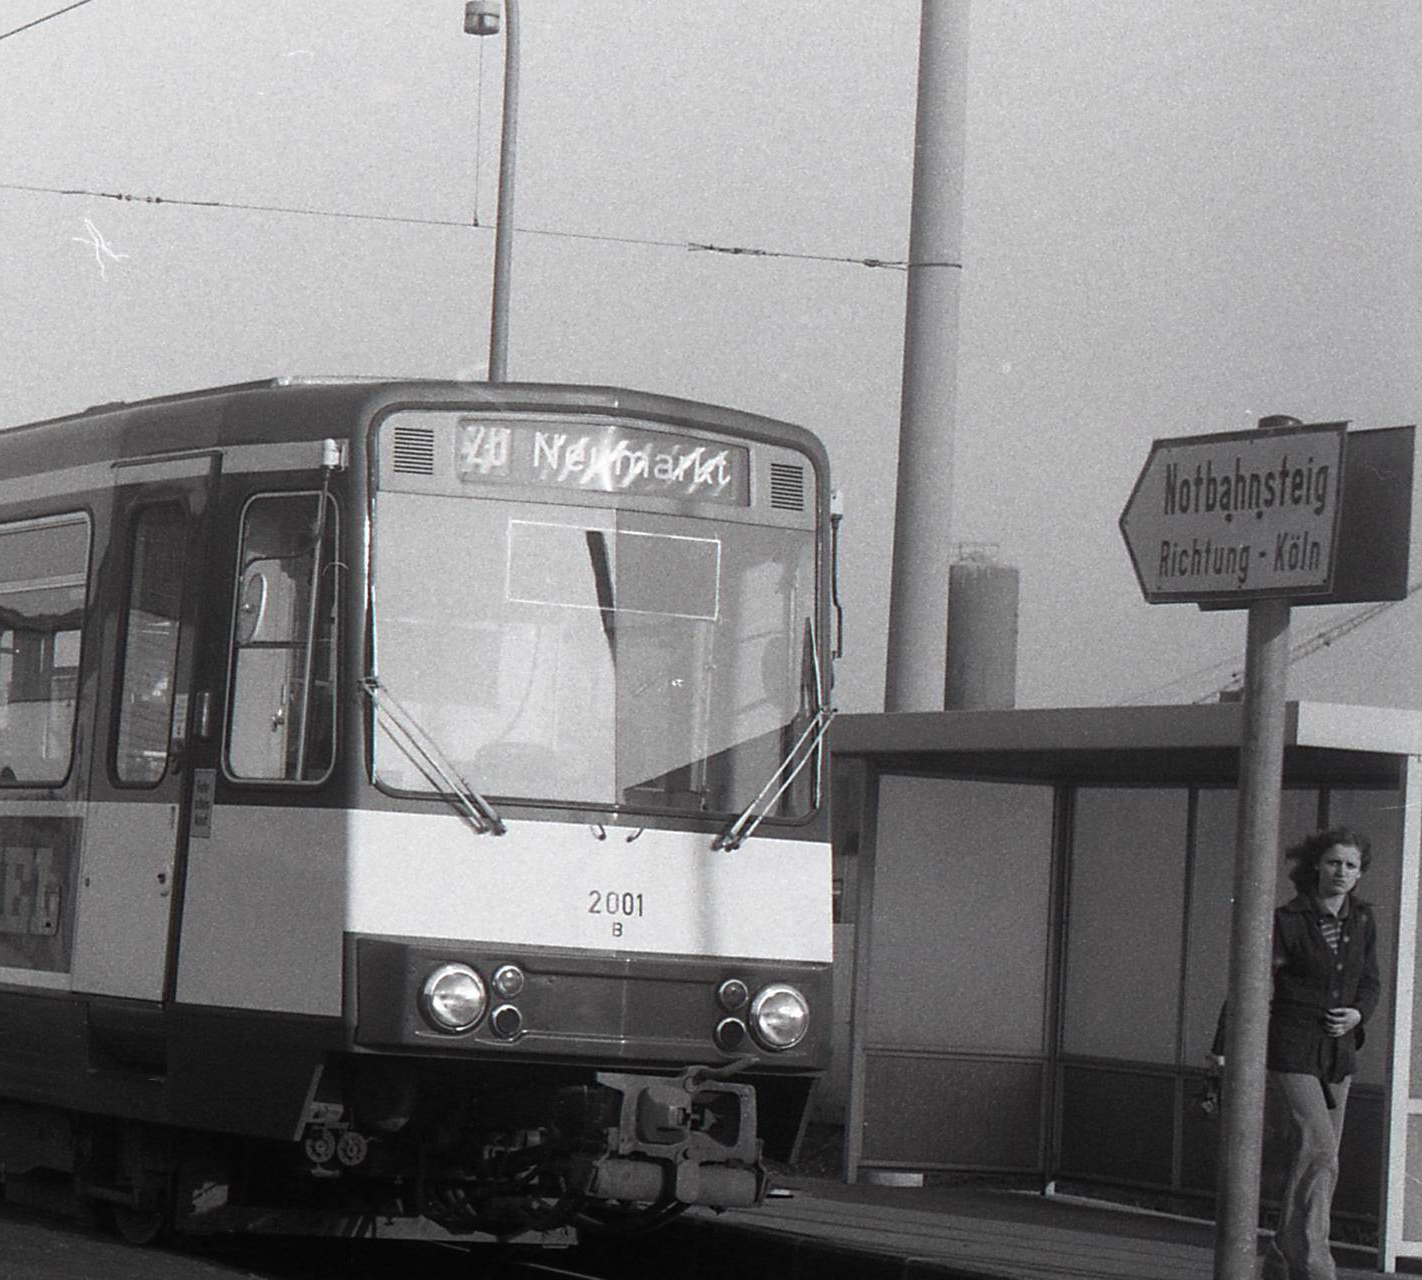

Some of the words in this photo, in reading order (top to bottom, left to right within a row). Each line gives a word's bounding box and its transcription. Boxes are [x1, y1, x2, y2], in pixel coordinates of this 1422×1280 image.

[533, 430, 732, 486] Neumarkt
[1163, 455, 1330, 516] Notbahnsteig
[1158, 538, 1251, 583] Richtung
[1273, 531, 1322, 573] Köln
[587, 890, 643, 917] 2001
[612, 921, 624, 938] B
